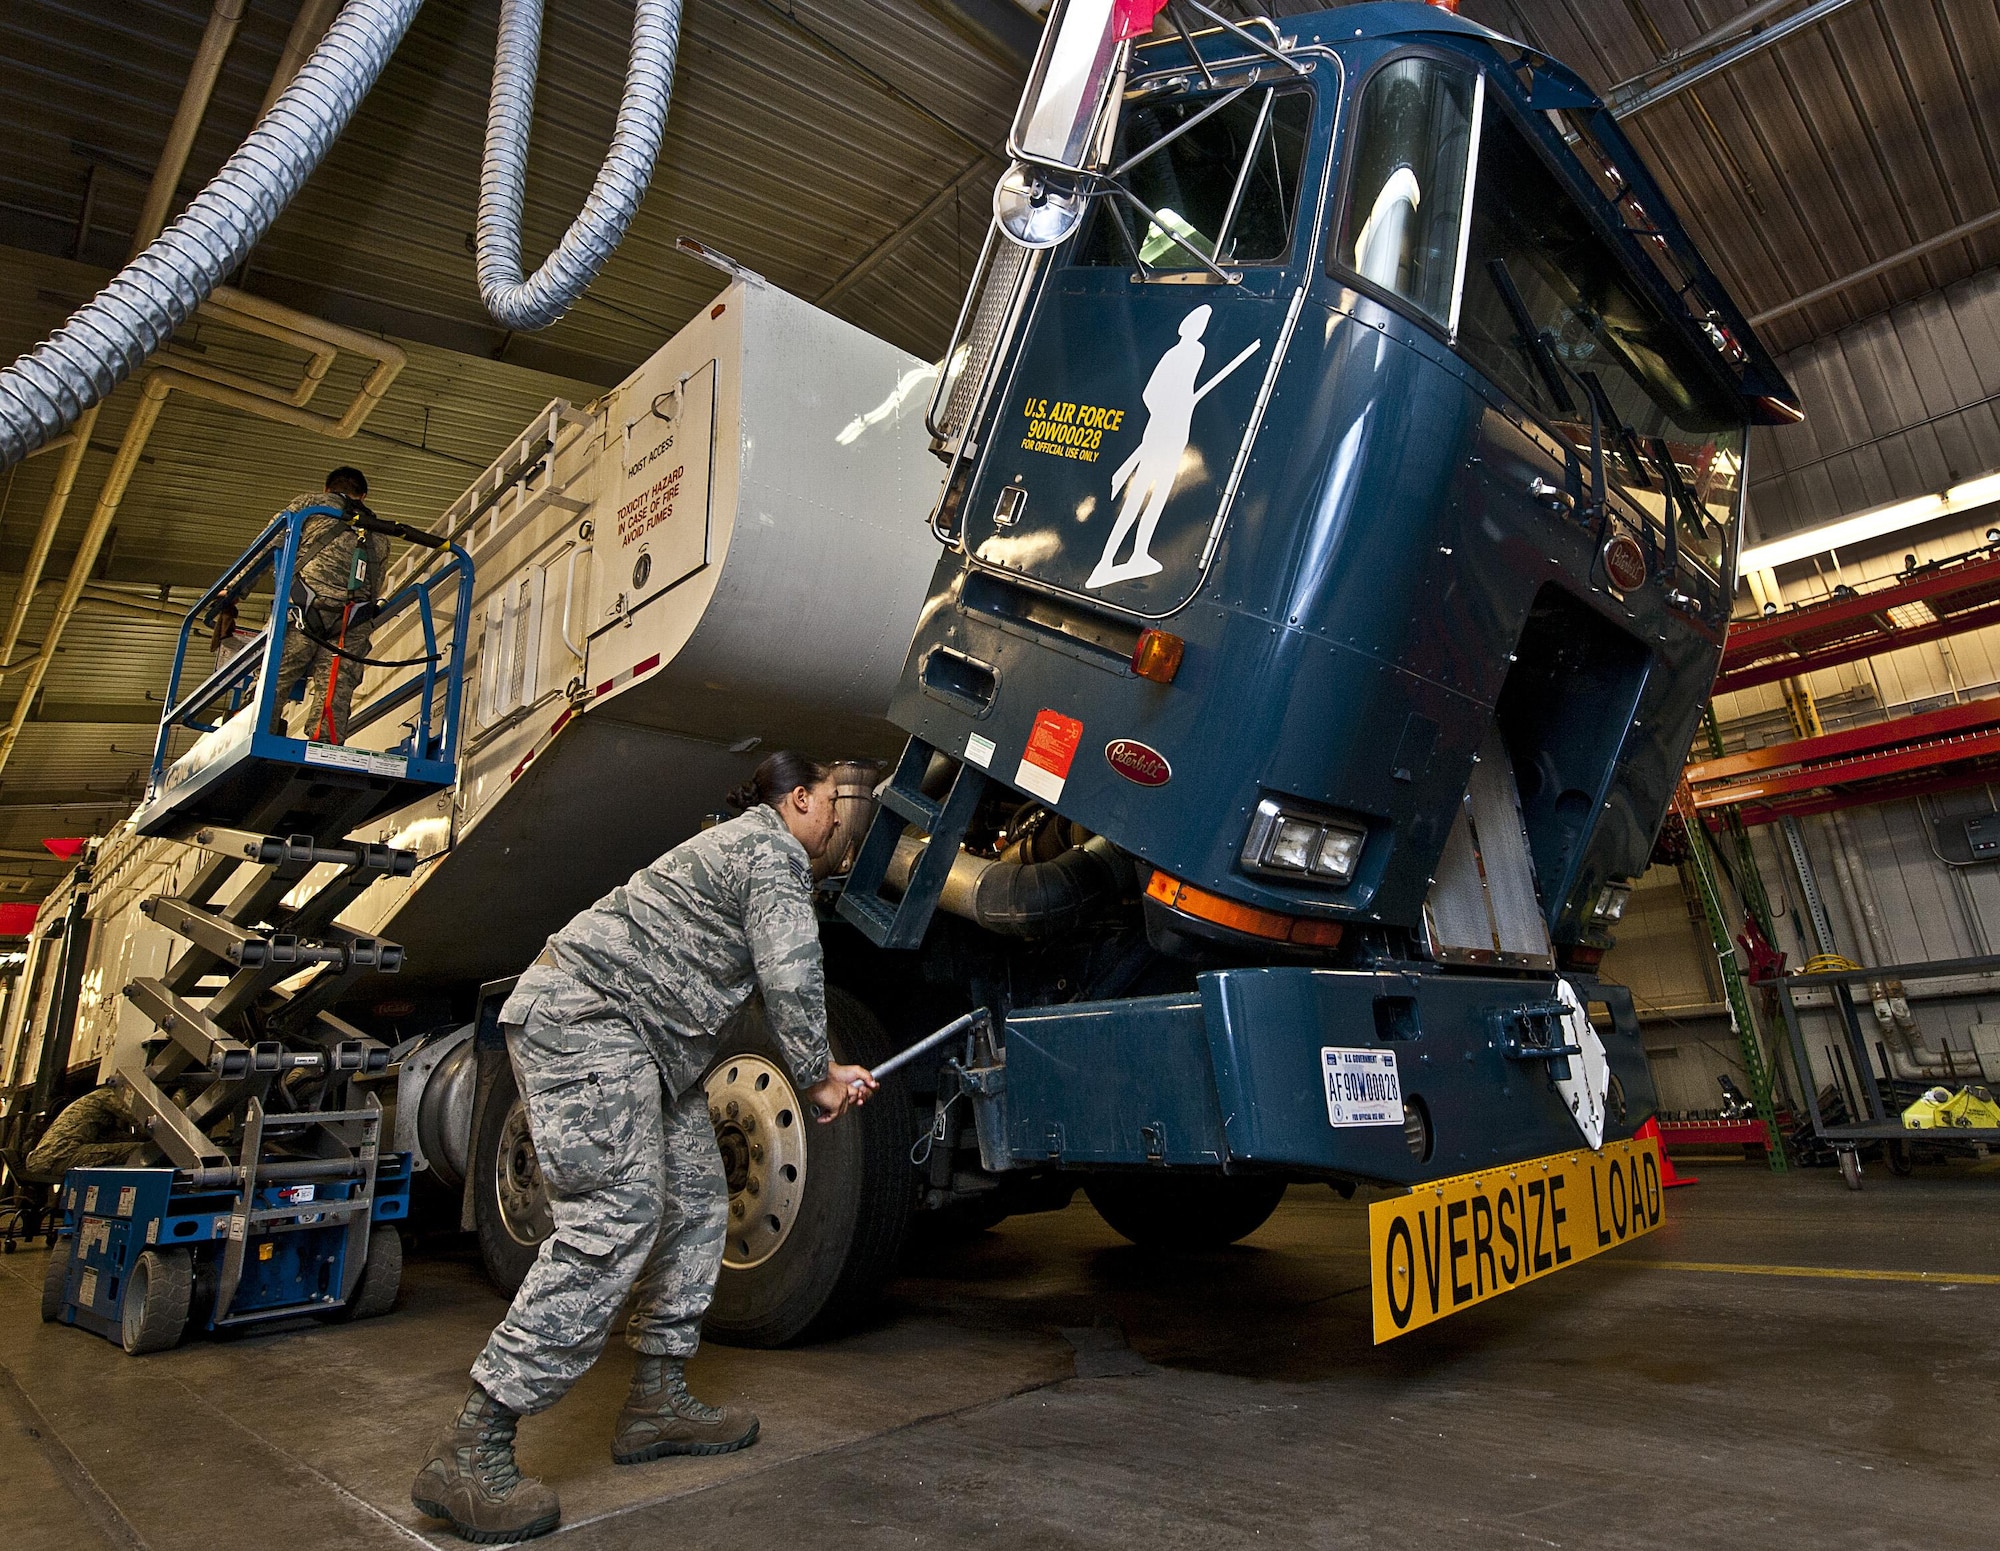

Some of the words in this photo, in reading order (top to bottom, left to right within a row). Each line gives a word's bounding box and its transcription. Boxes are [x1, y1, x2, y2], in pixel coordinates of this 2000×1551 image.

[1024, 397, 1048, 420] U.S.
[1048, 401, 1077, 424] AIR
[1076, 405, 1126, 432] FORCE
[1027, 419, 1103, 450] 90W00028
[628, 456, 647, 480] HOIST
[649, 435, 674, 462] ACCESS
[1020, 438, 1036, 452] FOR
[1034, 441, 1065, 457] OFFICIAL
[1065, 446, 1080, 460] USE
[1079, 449, 1100, 463] ONLY
[617, 490, 650, 522] TOXICITY
[651, 465, 685, 499] HAZARD
[617, 521, 626, 537] IN
[627, 506, 648, 530] CASE
[650, 498, 661, 515] OF
[662, 483, 681, 507] FIRE
[622, 524, 645, 548] AVOID
[646, 503, 674, 532] FUMES
[1110, 742, 1167, 779] Peterbilt
[1386, 1174, 1572, 1329] OVERSIZE
[1590, 1151, 1660, 1248] LOAD
